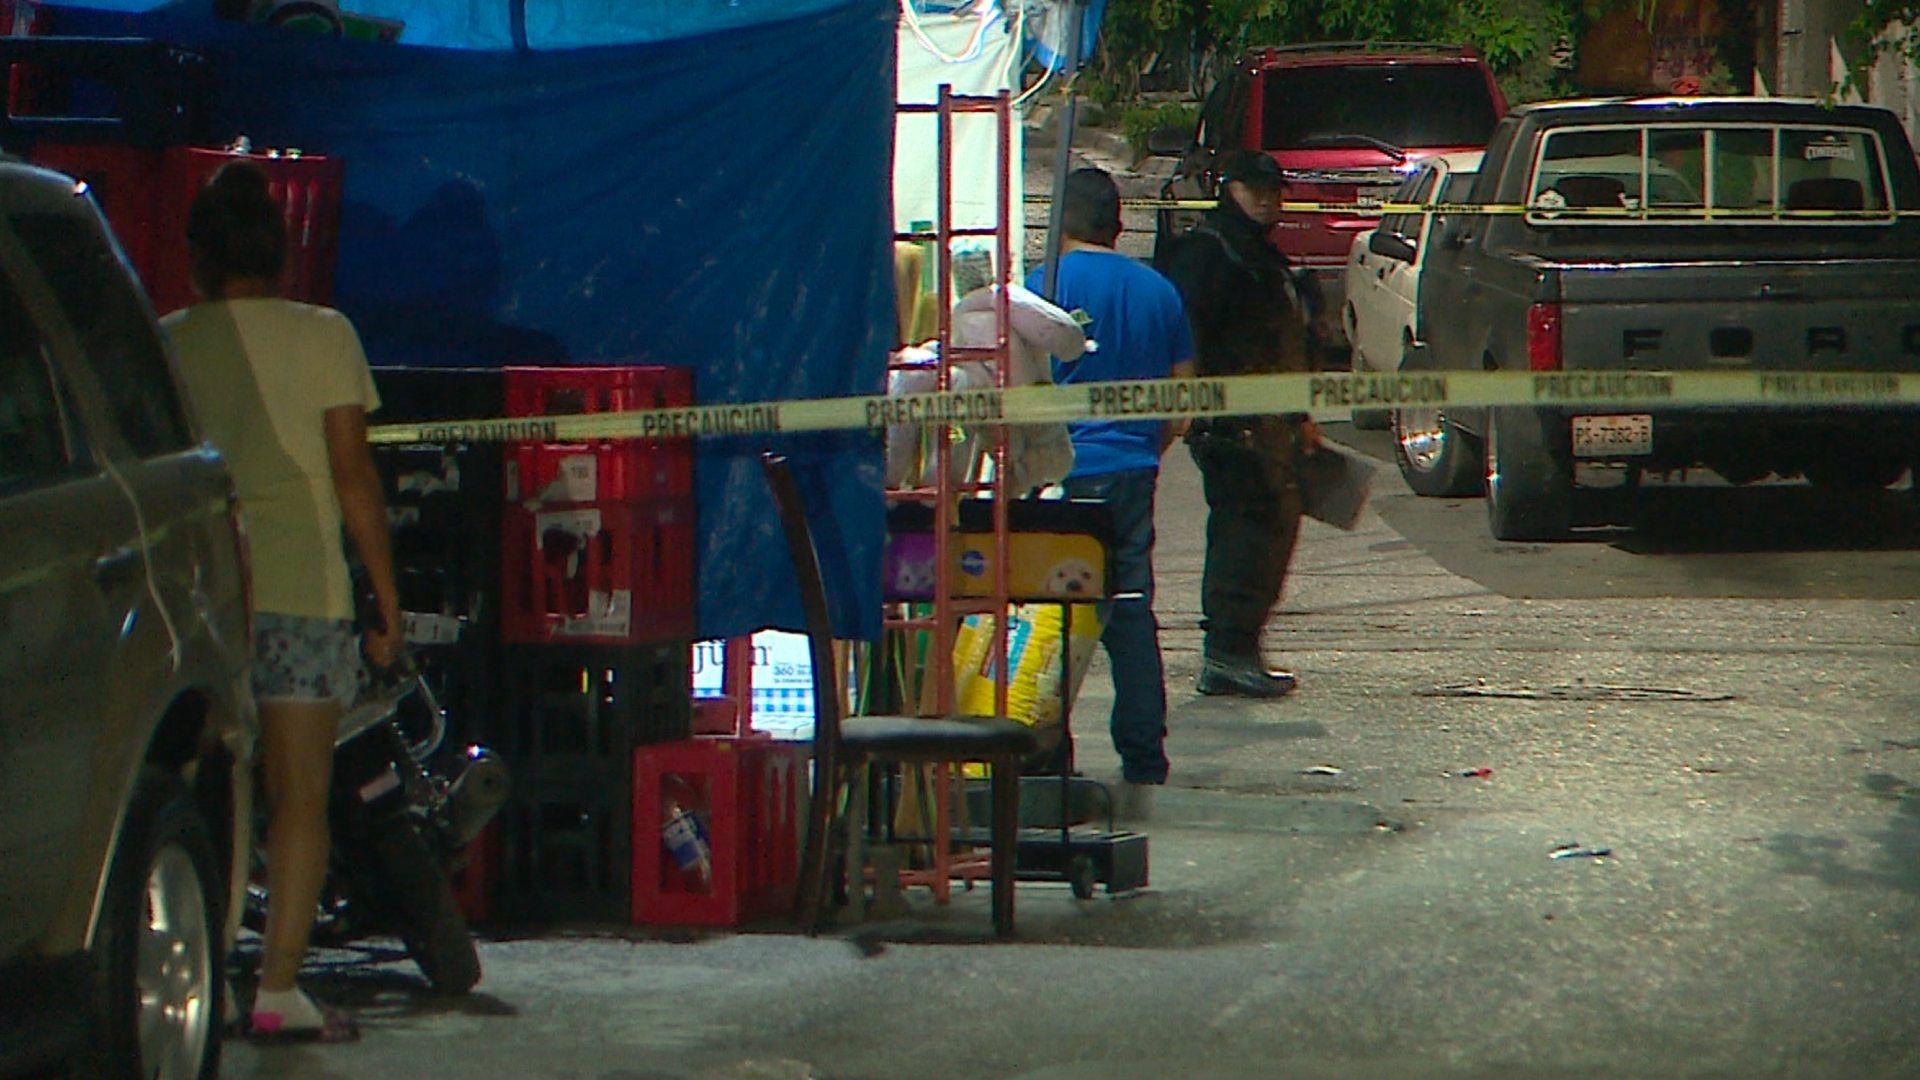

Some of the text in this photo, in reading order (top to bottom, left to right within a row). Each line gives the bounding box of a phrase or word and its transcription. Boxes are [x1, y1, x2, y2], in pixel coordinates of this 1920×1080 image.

[642, 406, 781, 438] PRECAUCION
[865, 390, 1004, 430] PRECAUCION
[1088, 381, 1227, 416] PRECAUCION
[1309, 376, 1448, 407] PRECAUCION
[1533, 373, 1674, 399] PRECAUCION
